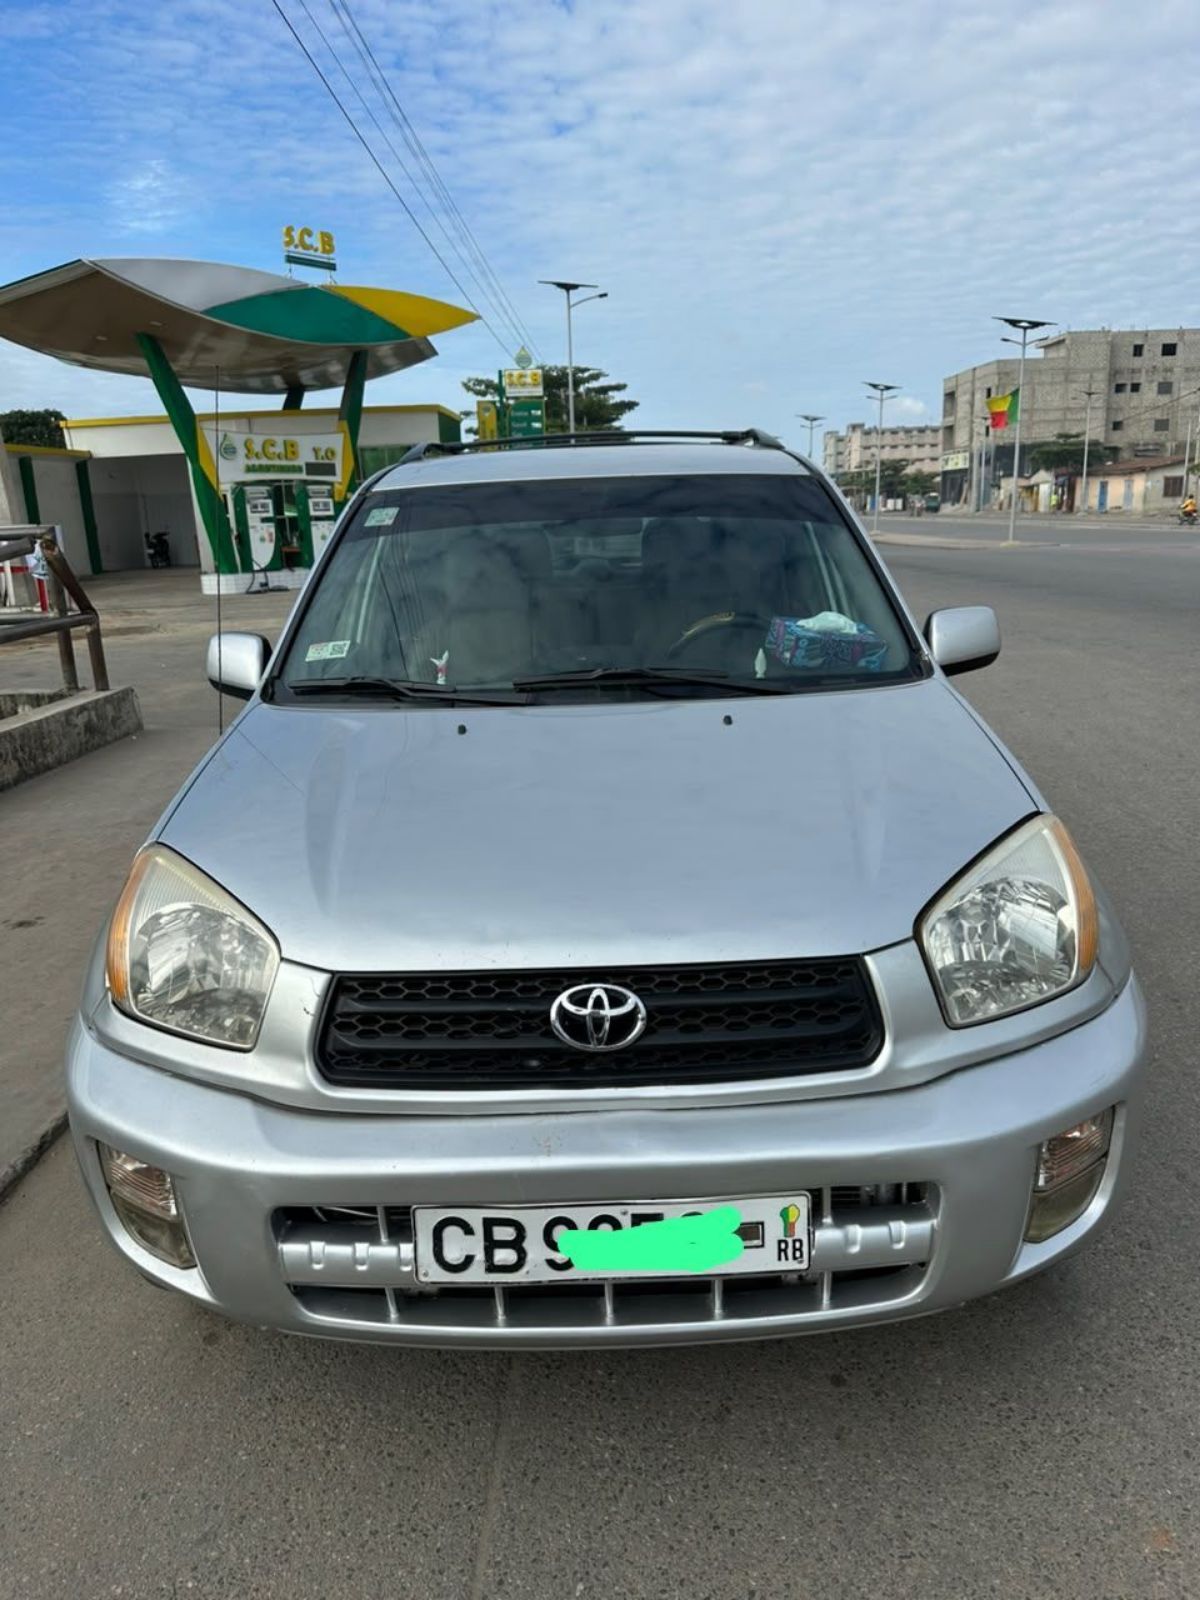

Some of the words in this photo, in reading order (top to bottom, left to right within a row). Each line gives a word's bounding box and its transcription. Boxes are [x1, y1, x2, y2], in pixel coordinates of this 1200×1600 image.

[283, 226, 335, 254] S.C.B
[244, 438, 299, 461] S.C.B
[432, 1215, 527, 1274] CB
[777, 1238, 803, 1261] RB
